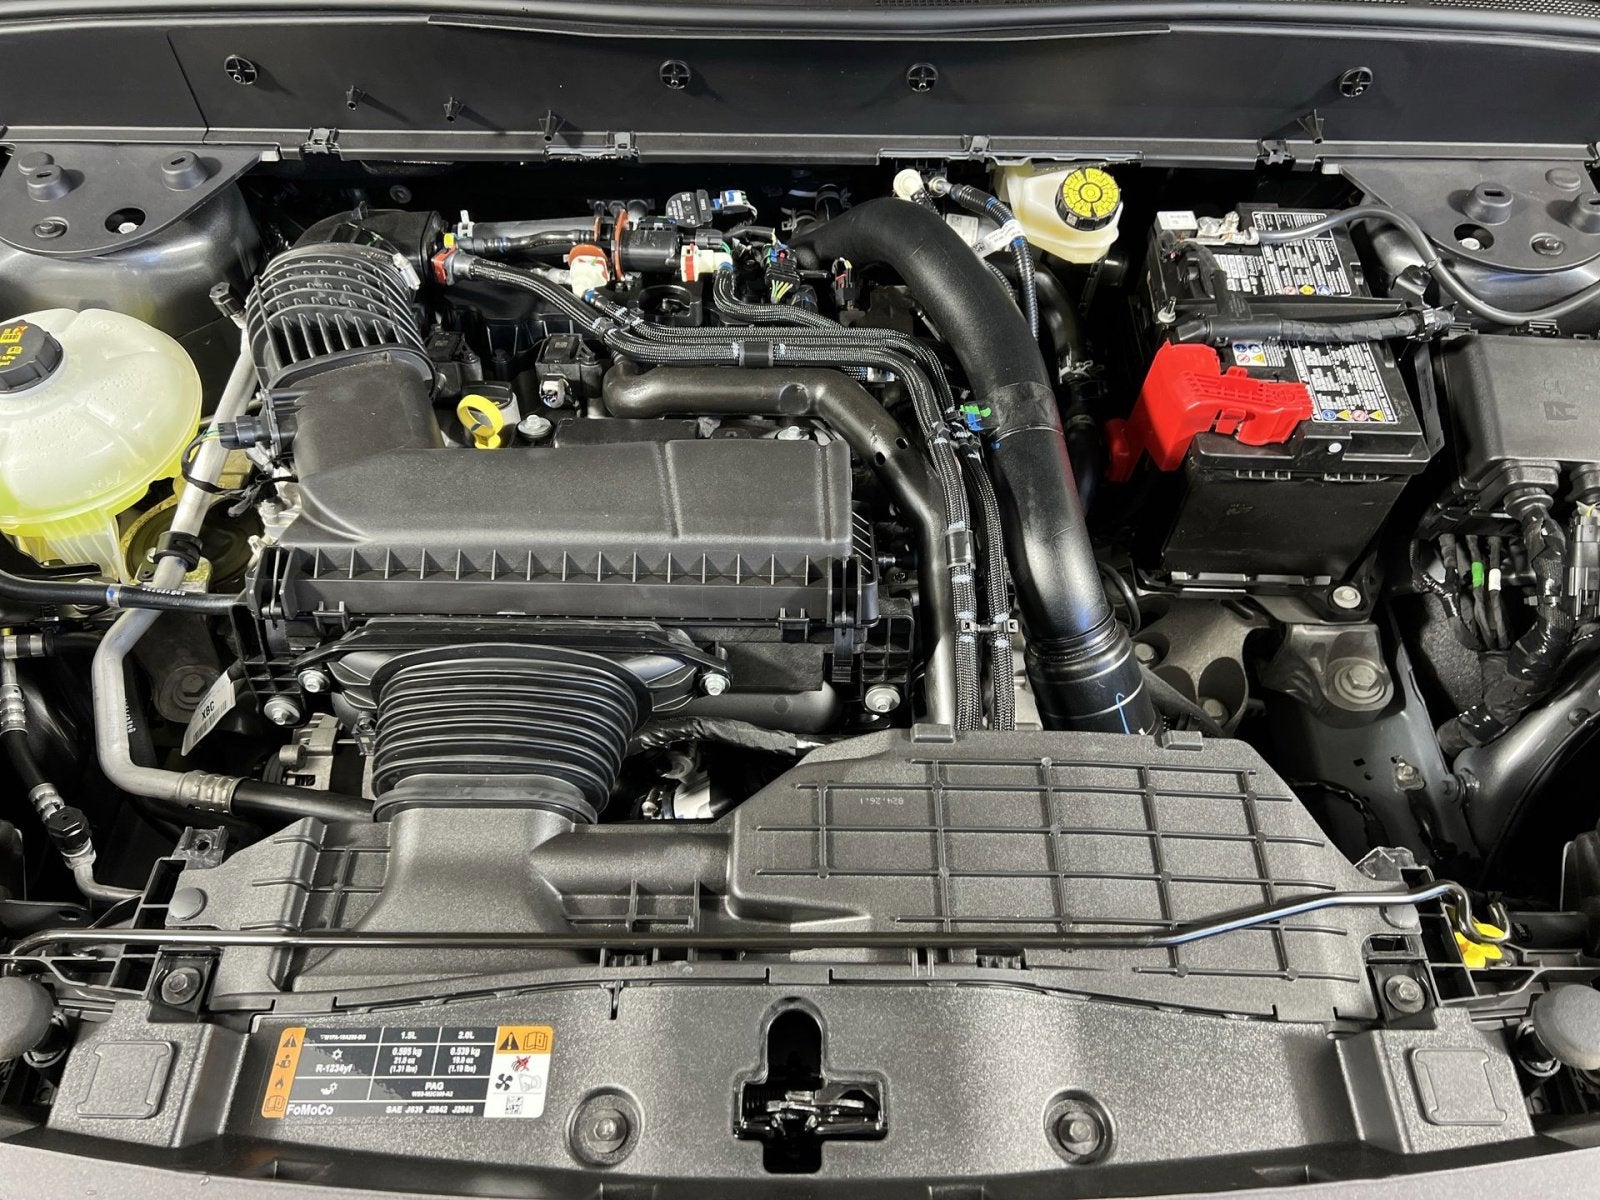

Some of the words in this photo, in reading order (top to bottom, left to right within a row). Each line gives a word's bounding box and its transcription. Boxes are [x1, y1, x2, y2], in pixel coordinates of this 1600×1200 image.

[201, 700, 215, 720] XBC
[400, 1031, 417, 1040] 1.5L
[457, 1030, 475, 1040] 2.0L
[412, 1047, 423, 1057] kg
[470, 1047, 481, 1057] kg
[315, 1063, 354, 1074] R-1234yf
[424, 1082, 444, 1090] PAG
[286, 1104, 334, 1115] FoMoCo
[385, 1105, 403, 1114] SAE
